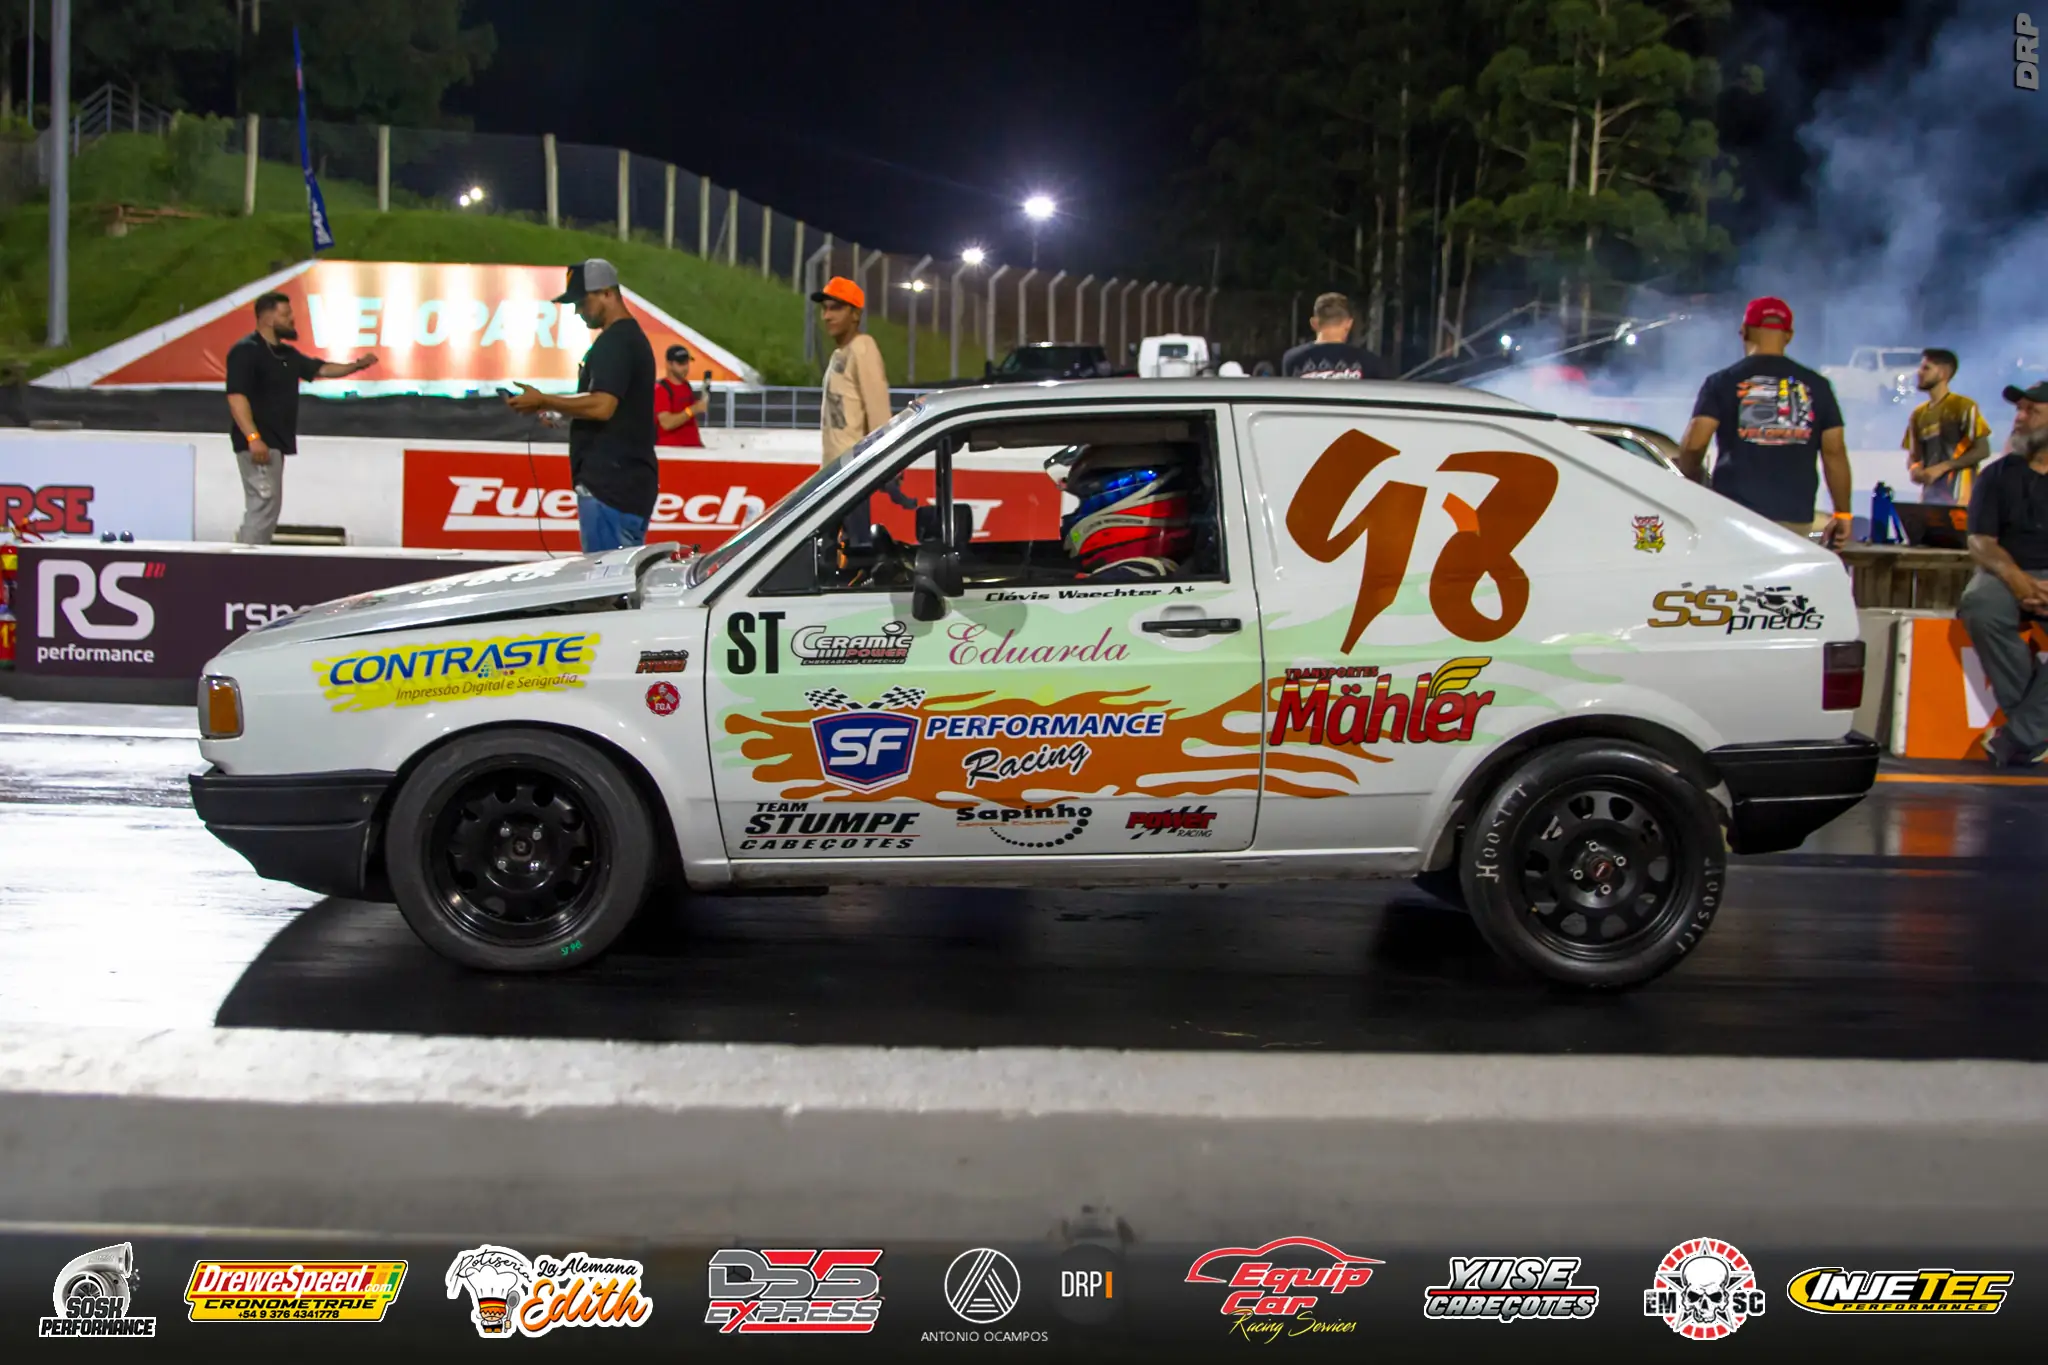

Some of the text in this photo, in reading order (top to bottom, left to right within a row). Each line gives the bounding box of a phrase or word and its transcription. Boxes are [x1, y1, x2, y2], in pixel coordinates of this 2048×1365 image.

[1286, 428, 1560, 655] 98
[37, 559, 155, 640] RS
[985, 585, 1196, 602] Clóvis Waechter A+
[1647, 589, 1738, 628] SS
[37, 643, 155, 663] performance
[726, 611, 787, 675] ST
[845, 648, 908, 658] POWER
[946, 622, 1130, 665] Eduarda
[329, 635, 585, 686] CONTRASTE
[1285, 666, 1379, 678] TRANSPORTES
[396, 671, 578, 701] Impressão Digital e Serigrafia
[1269, 673, 1496, 746] Mähler
[829, 714, 1164, 766] SF PERFORMANCE
[964, 741, 1091, 787] Racing
[756, 802, 809, 813] TEAM
[956, 804, 1093, 822] Sapinho
[745, 812, 921, 835] STUMPF
[1177, 829, 1213, 838] RACING
[739, 838, 914, 851] CABEÇOTES
